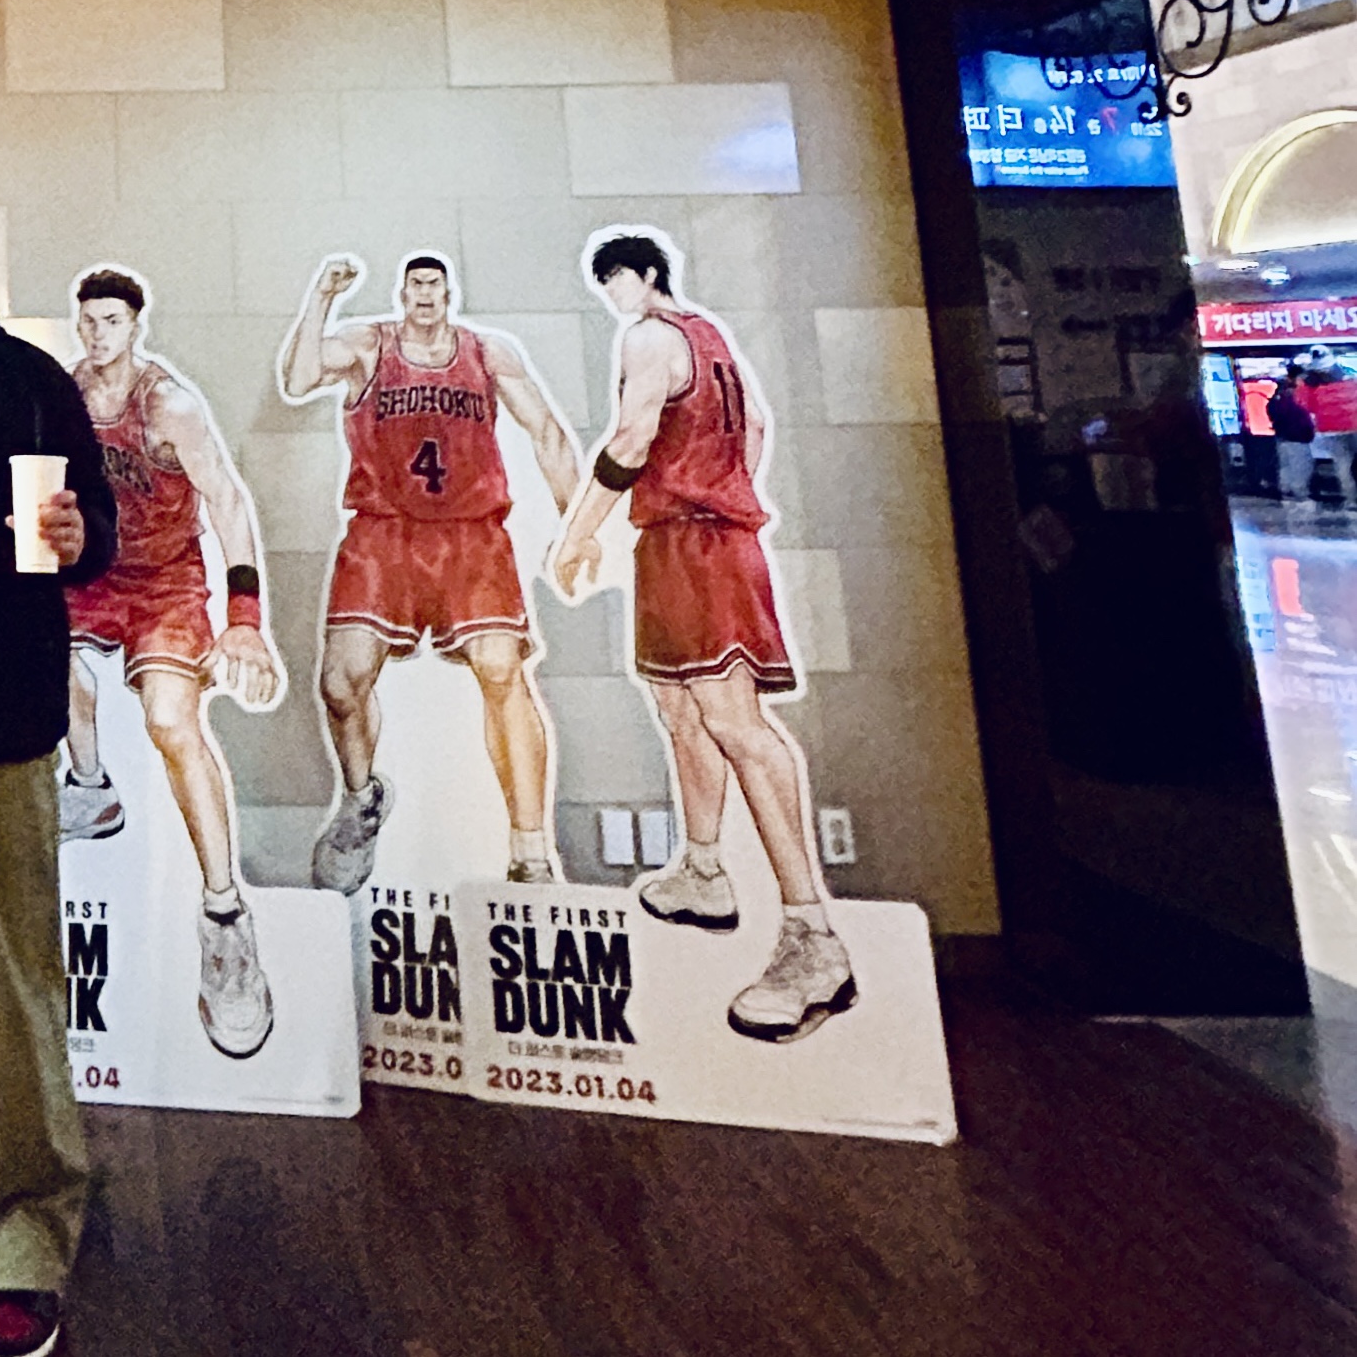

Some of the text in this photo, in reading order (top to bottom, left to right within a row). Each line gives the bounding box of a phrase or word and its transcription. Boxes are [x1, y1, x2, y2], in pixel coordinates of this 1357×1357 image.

[1211, 310, 1294, 336] 기다리지
[375, 384, 486, 423] SHOHOKU
[408, 439, 447, 495] 4
[371, 886, 450, 911] THE FI
[487, 901, 627, 929] THE FIRST
[370, 908, 458, 970] SLA
[489, 924, 632, 988] SLAM
[66, 976, 108, 1032] K
[492, 978, 638, 1045] DUNK
[362, 1044, 463, 1081] 2023.0
[485, 1063, 657, 1104] 2023.01.04
